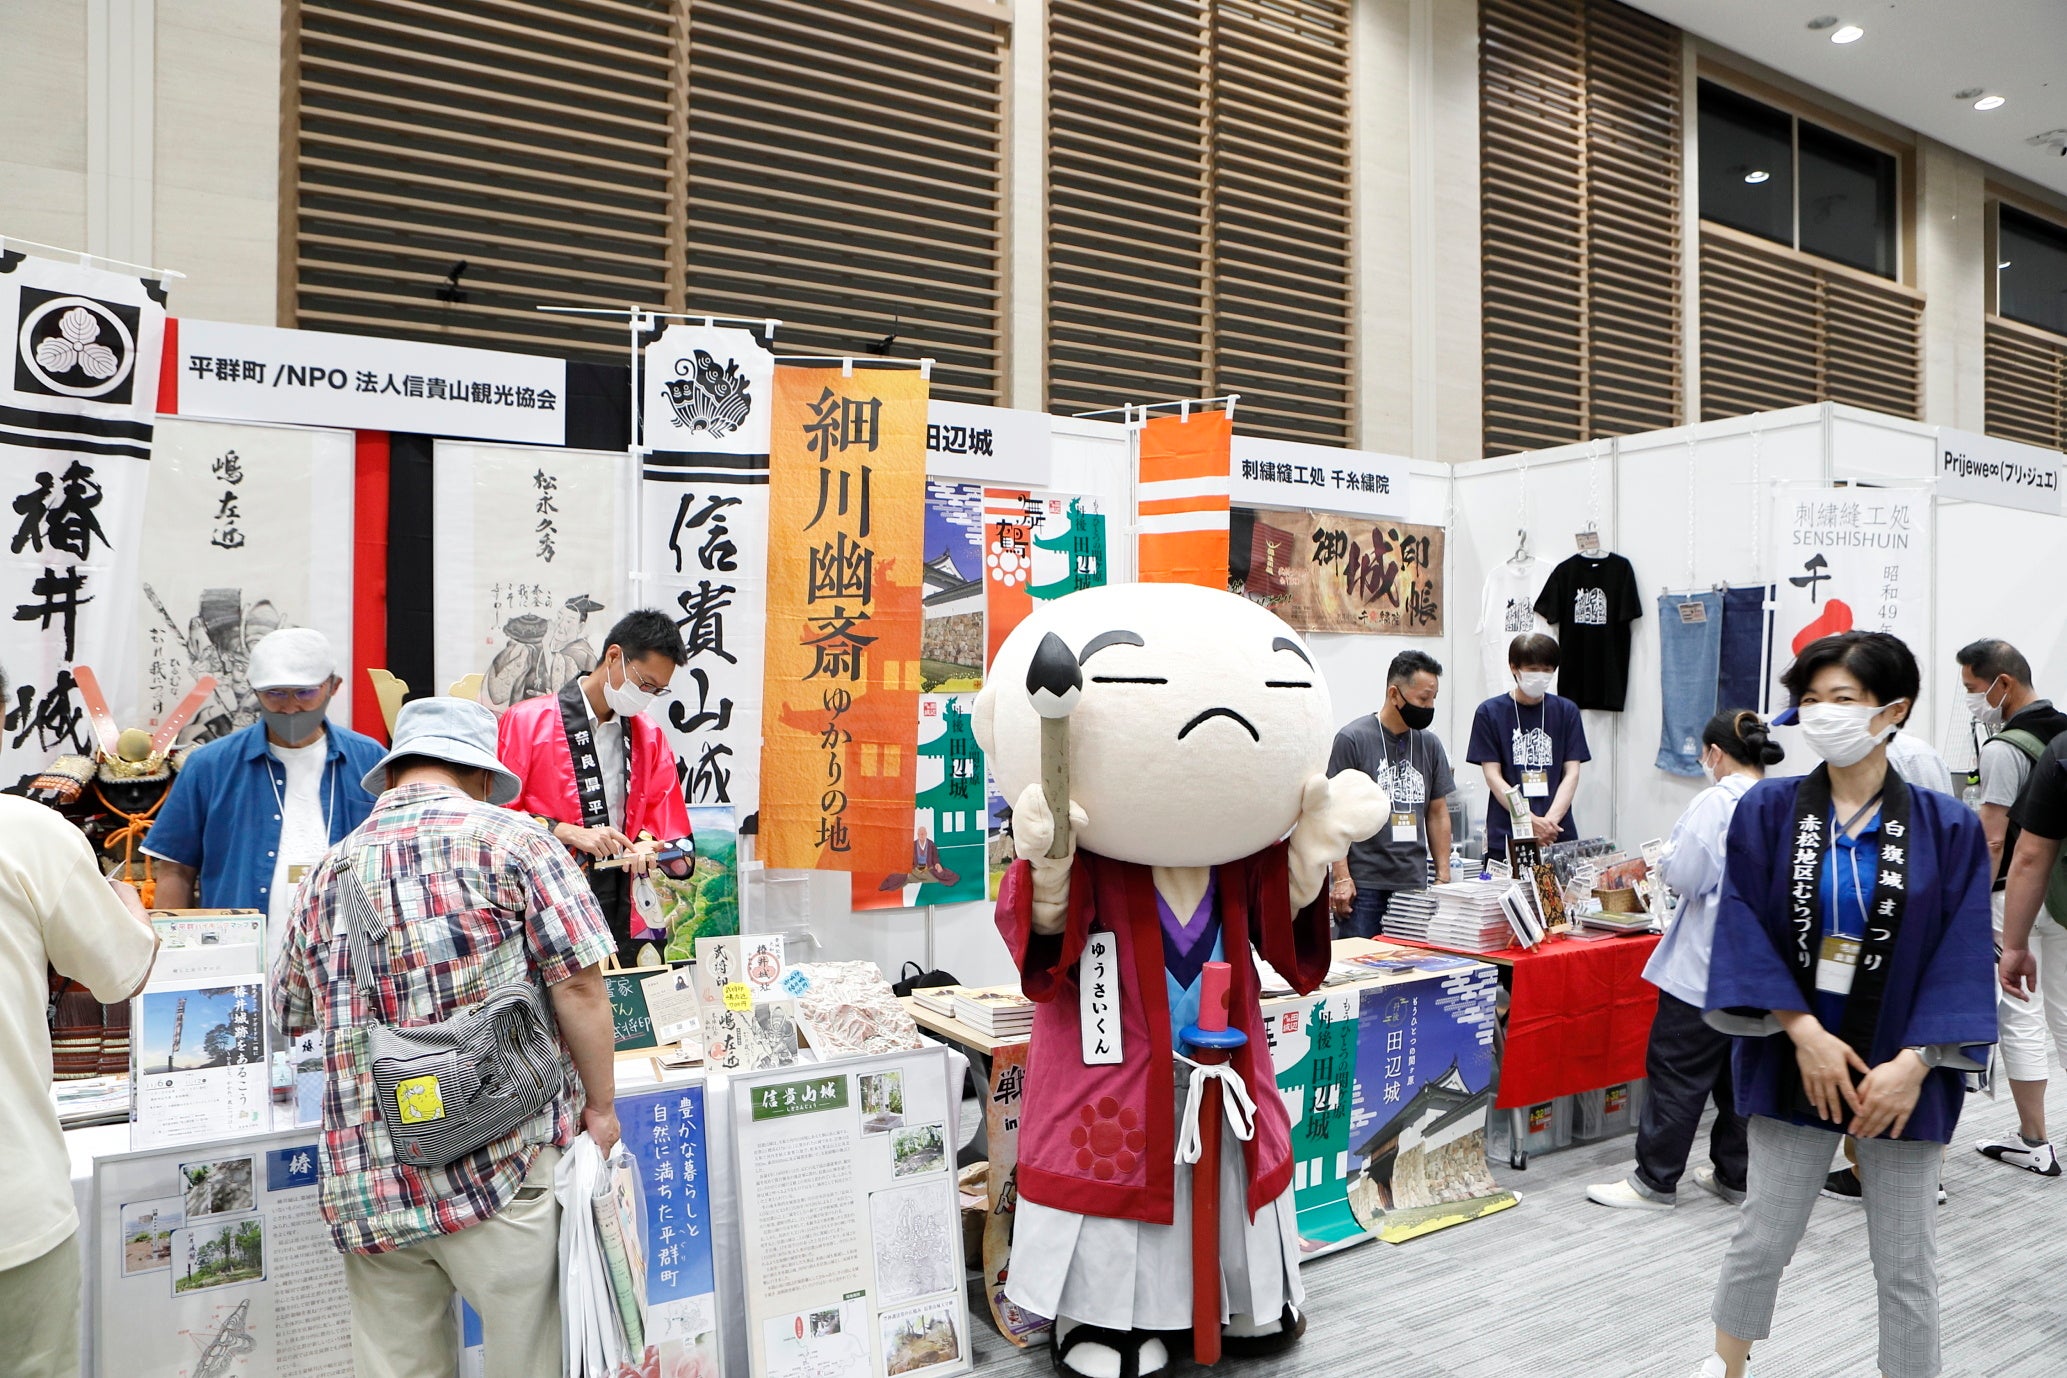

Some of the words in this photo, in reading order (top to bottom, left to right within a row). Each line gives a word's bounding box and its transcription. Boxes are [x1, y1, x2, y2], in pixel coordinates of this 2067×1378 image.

[189, 355, 266, 384] 平群町
[355, 371, 557, 411] 法人信貴山観光協会
[212, 450, 245, 549] 嶋左近
[533, 468, 559, 563] 松永久秀
[1242, 460, 1325, 487] 刺繍縫工処
[1331, 469, 1390, 495] 千糸繍院
[1793, 502, 1911, 531] 刺繍縫工処
[1793, 530, 1909, 549] SENSHISHUIN
[668, 493, 744, 804] 信貴山城
[1792, 814, 1823, 968] 赤松地区むらづくり
[1091, 942, 1112, 1055] ゆうさいくん
[762, 1081, 837, 1108] 信貴山城
[1383, 1030, 1403, 1104] 田辺城
[1005, 1118, 1018, 1131] in
[652, 1104, 680, 1287] 自然に満ちた平群町
[678, 1097, 700, 1237] 豊かな暮らしと
